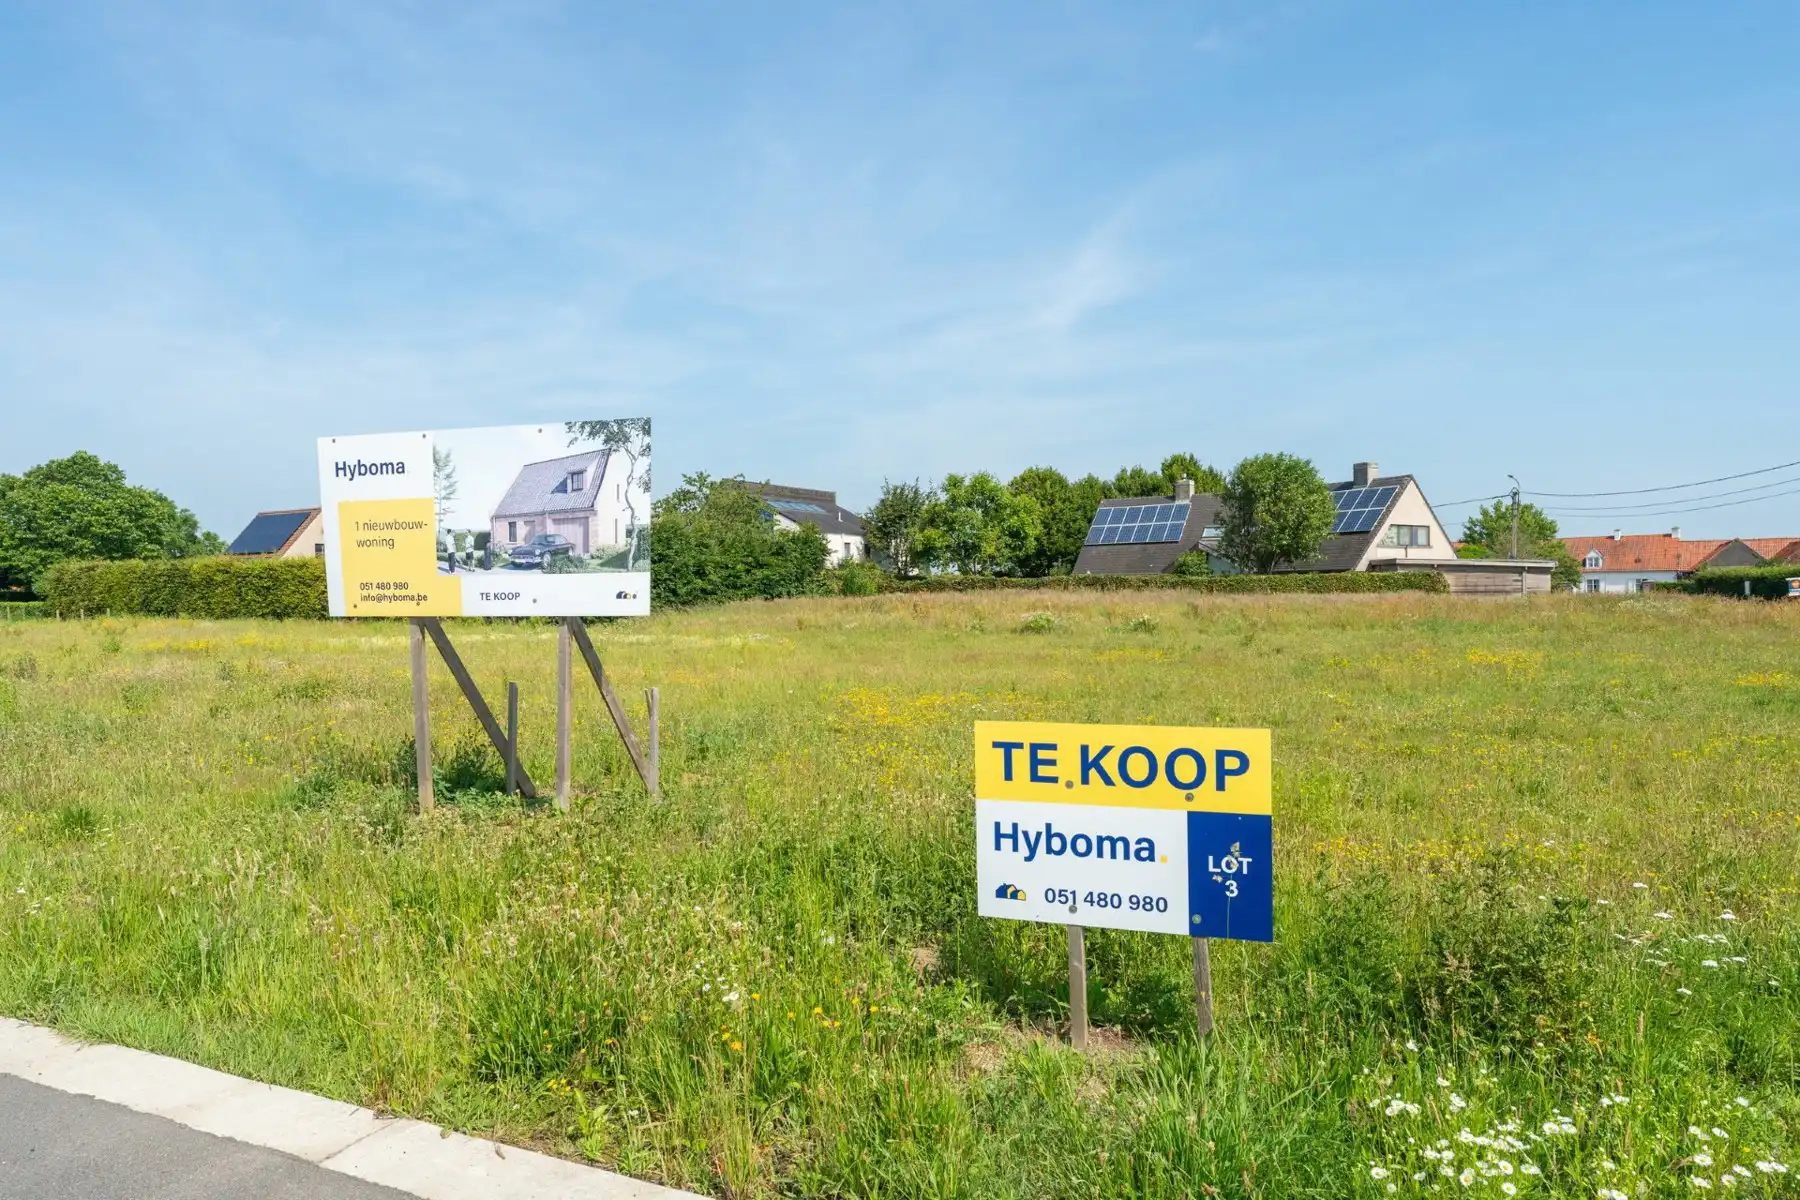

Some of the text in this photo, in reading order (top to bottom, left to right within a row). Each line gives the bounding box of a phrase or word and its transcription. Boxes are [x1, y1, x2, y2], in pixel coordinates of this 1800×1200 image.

[354, 519, 428, 531] 1 nieuwbouw-
[356, 536, 395, 550] woning
[359, 581, 409, 591] 051 480 980
[360, 592, 428, 604] info@hyboma.be
[479, 591, 521, 600] TE KOOP
[991, 741, 1251, 792] TE KOOP
[1207, 855, 1252, 874] LOT
[1225, 880, 1238, 897] 3
[1044, 887, 1168, 913] 051 480 980
